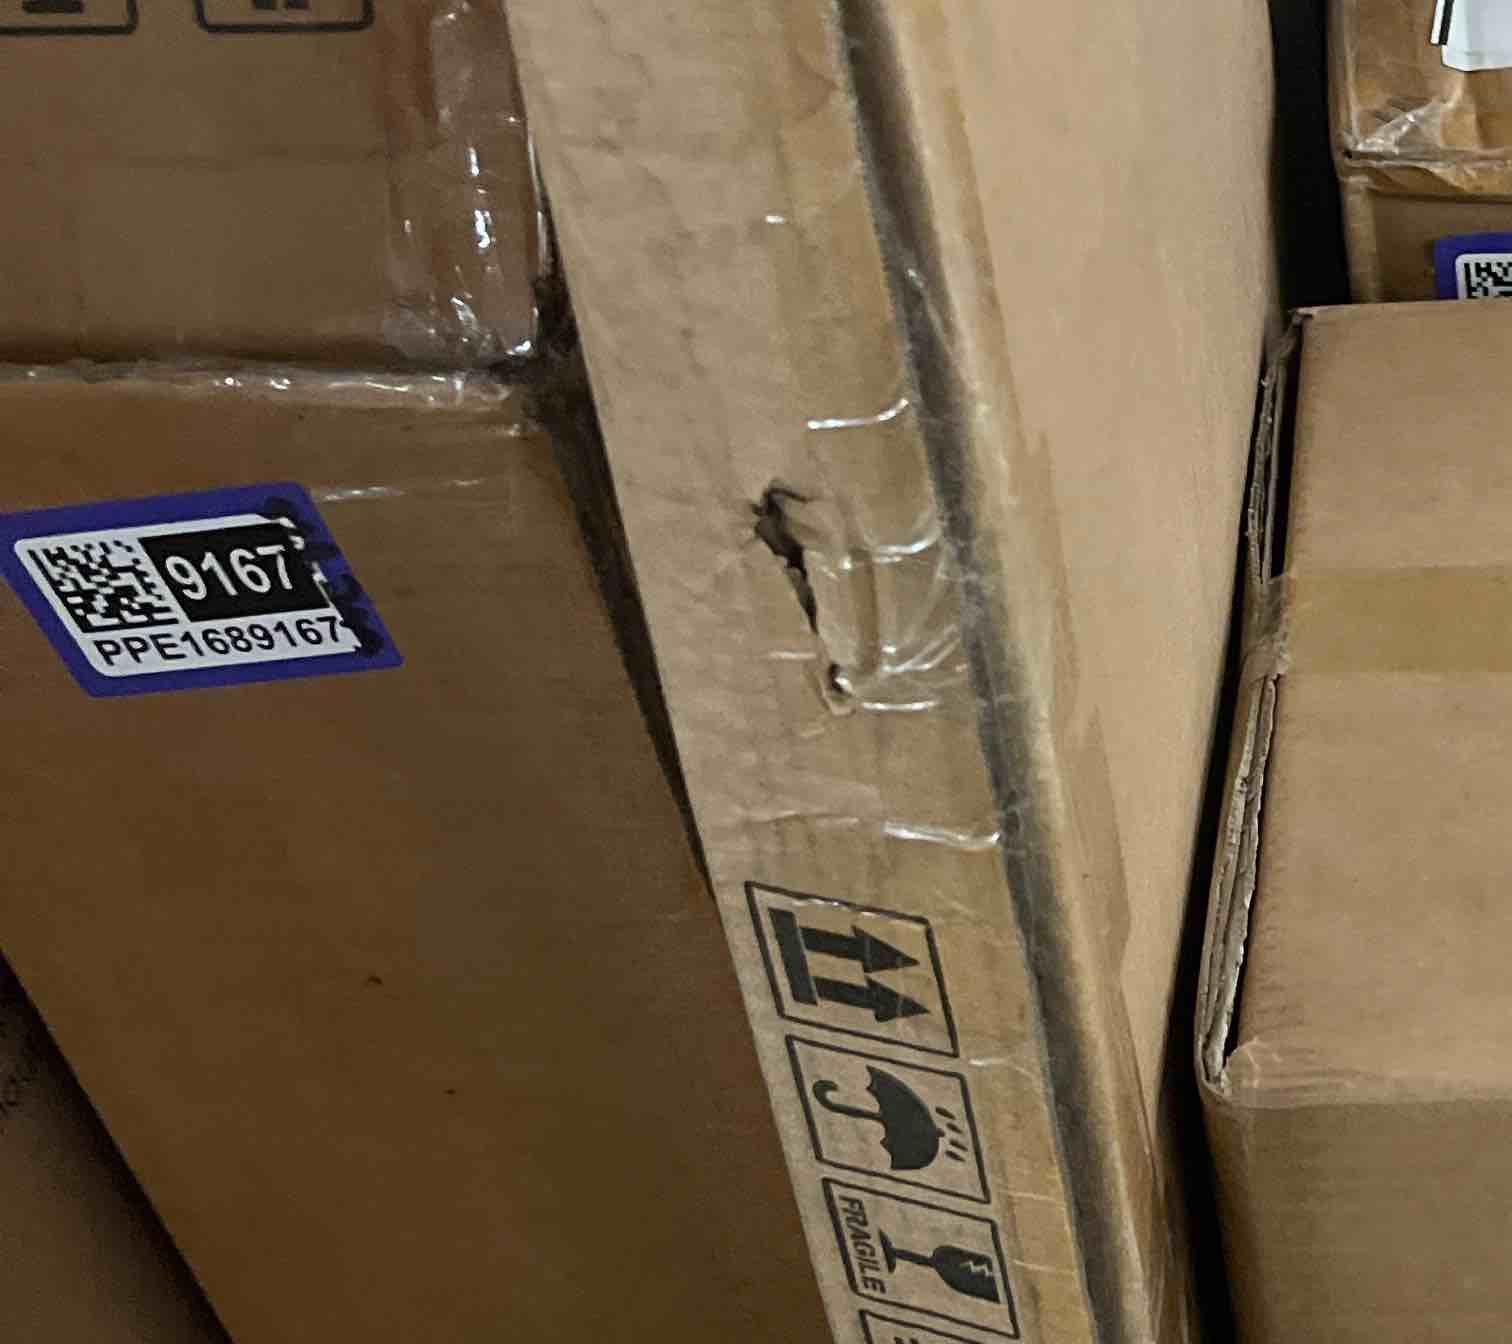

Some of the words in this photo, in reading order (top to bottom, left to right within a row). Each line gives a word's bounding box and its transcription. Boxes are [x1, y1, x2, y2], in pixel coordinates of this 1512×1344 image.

[164, 545, 293, 600] 9167
[94, 616, 342, 666] PPE1689167
[838, 1195, 886, 1294] FRAGILE
